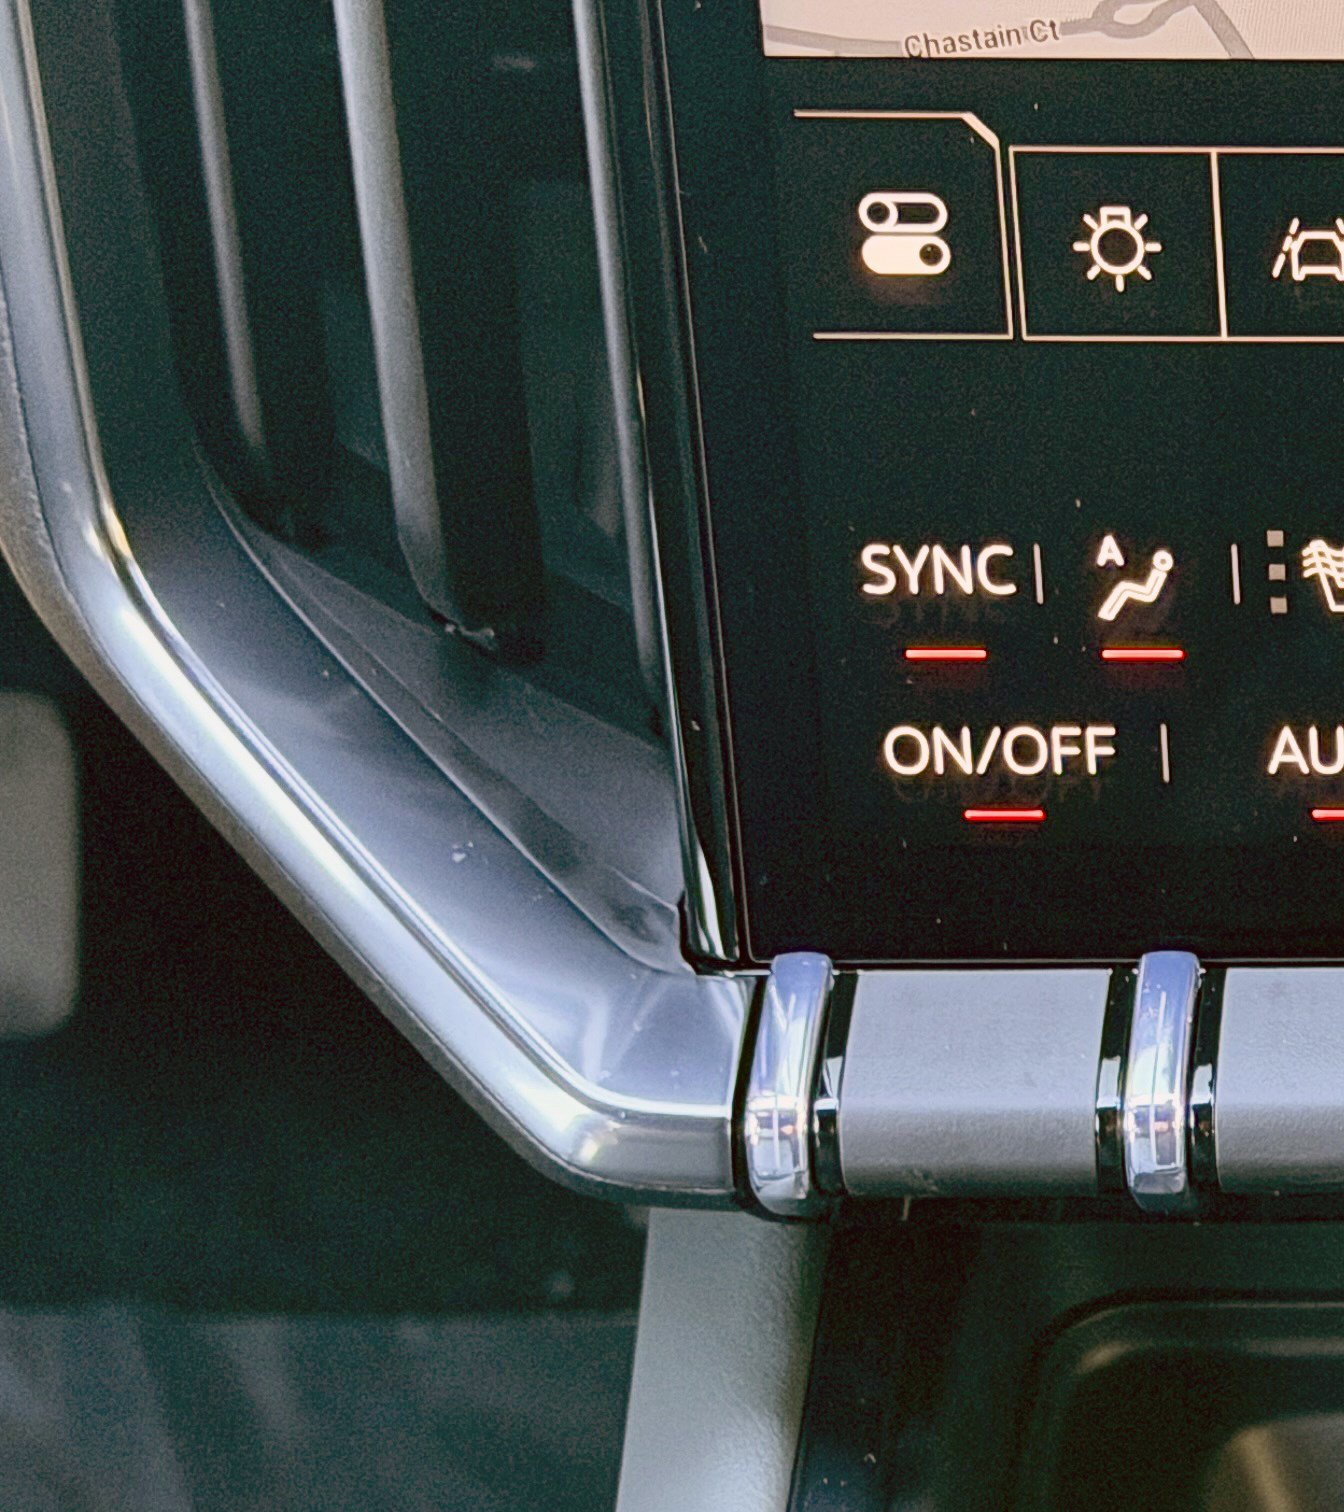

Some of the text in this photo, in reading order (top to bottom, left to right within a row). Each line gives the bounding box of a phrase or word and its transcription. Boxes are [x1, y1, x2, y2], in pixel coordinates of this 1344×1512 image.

[904, 18, 1059, 57] Chastain Ct
[861, 543, 1017, 596] SYNC
[1096, 534, 1125, 567] A
[883, 725, 1116, 776] ON/OFF
